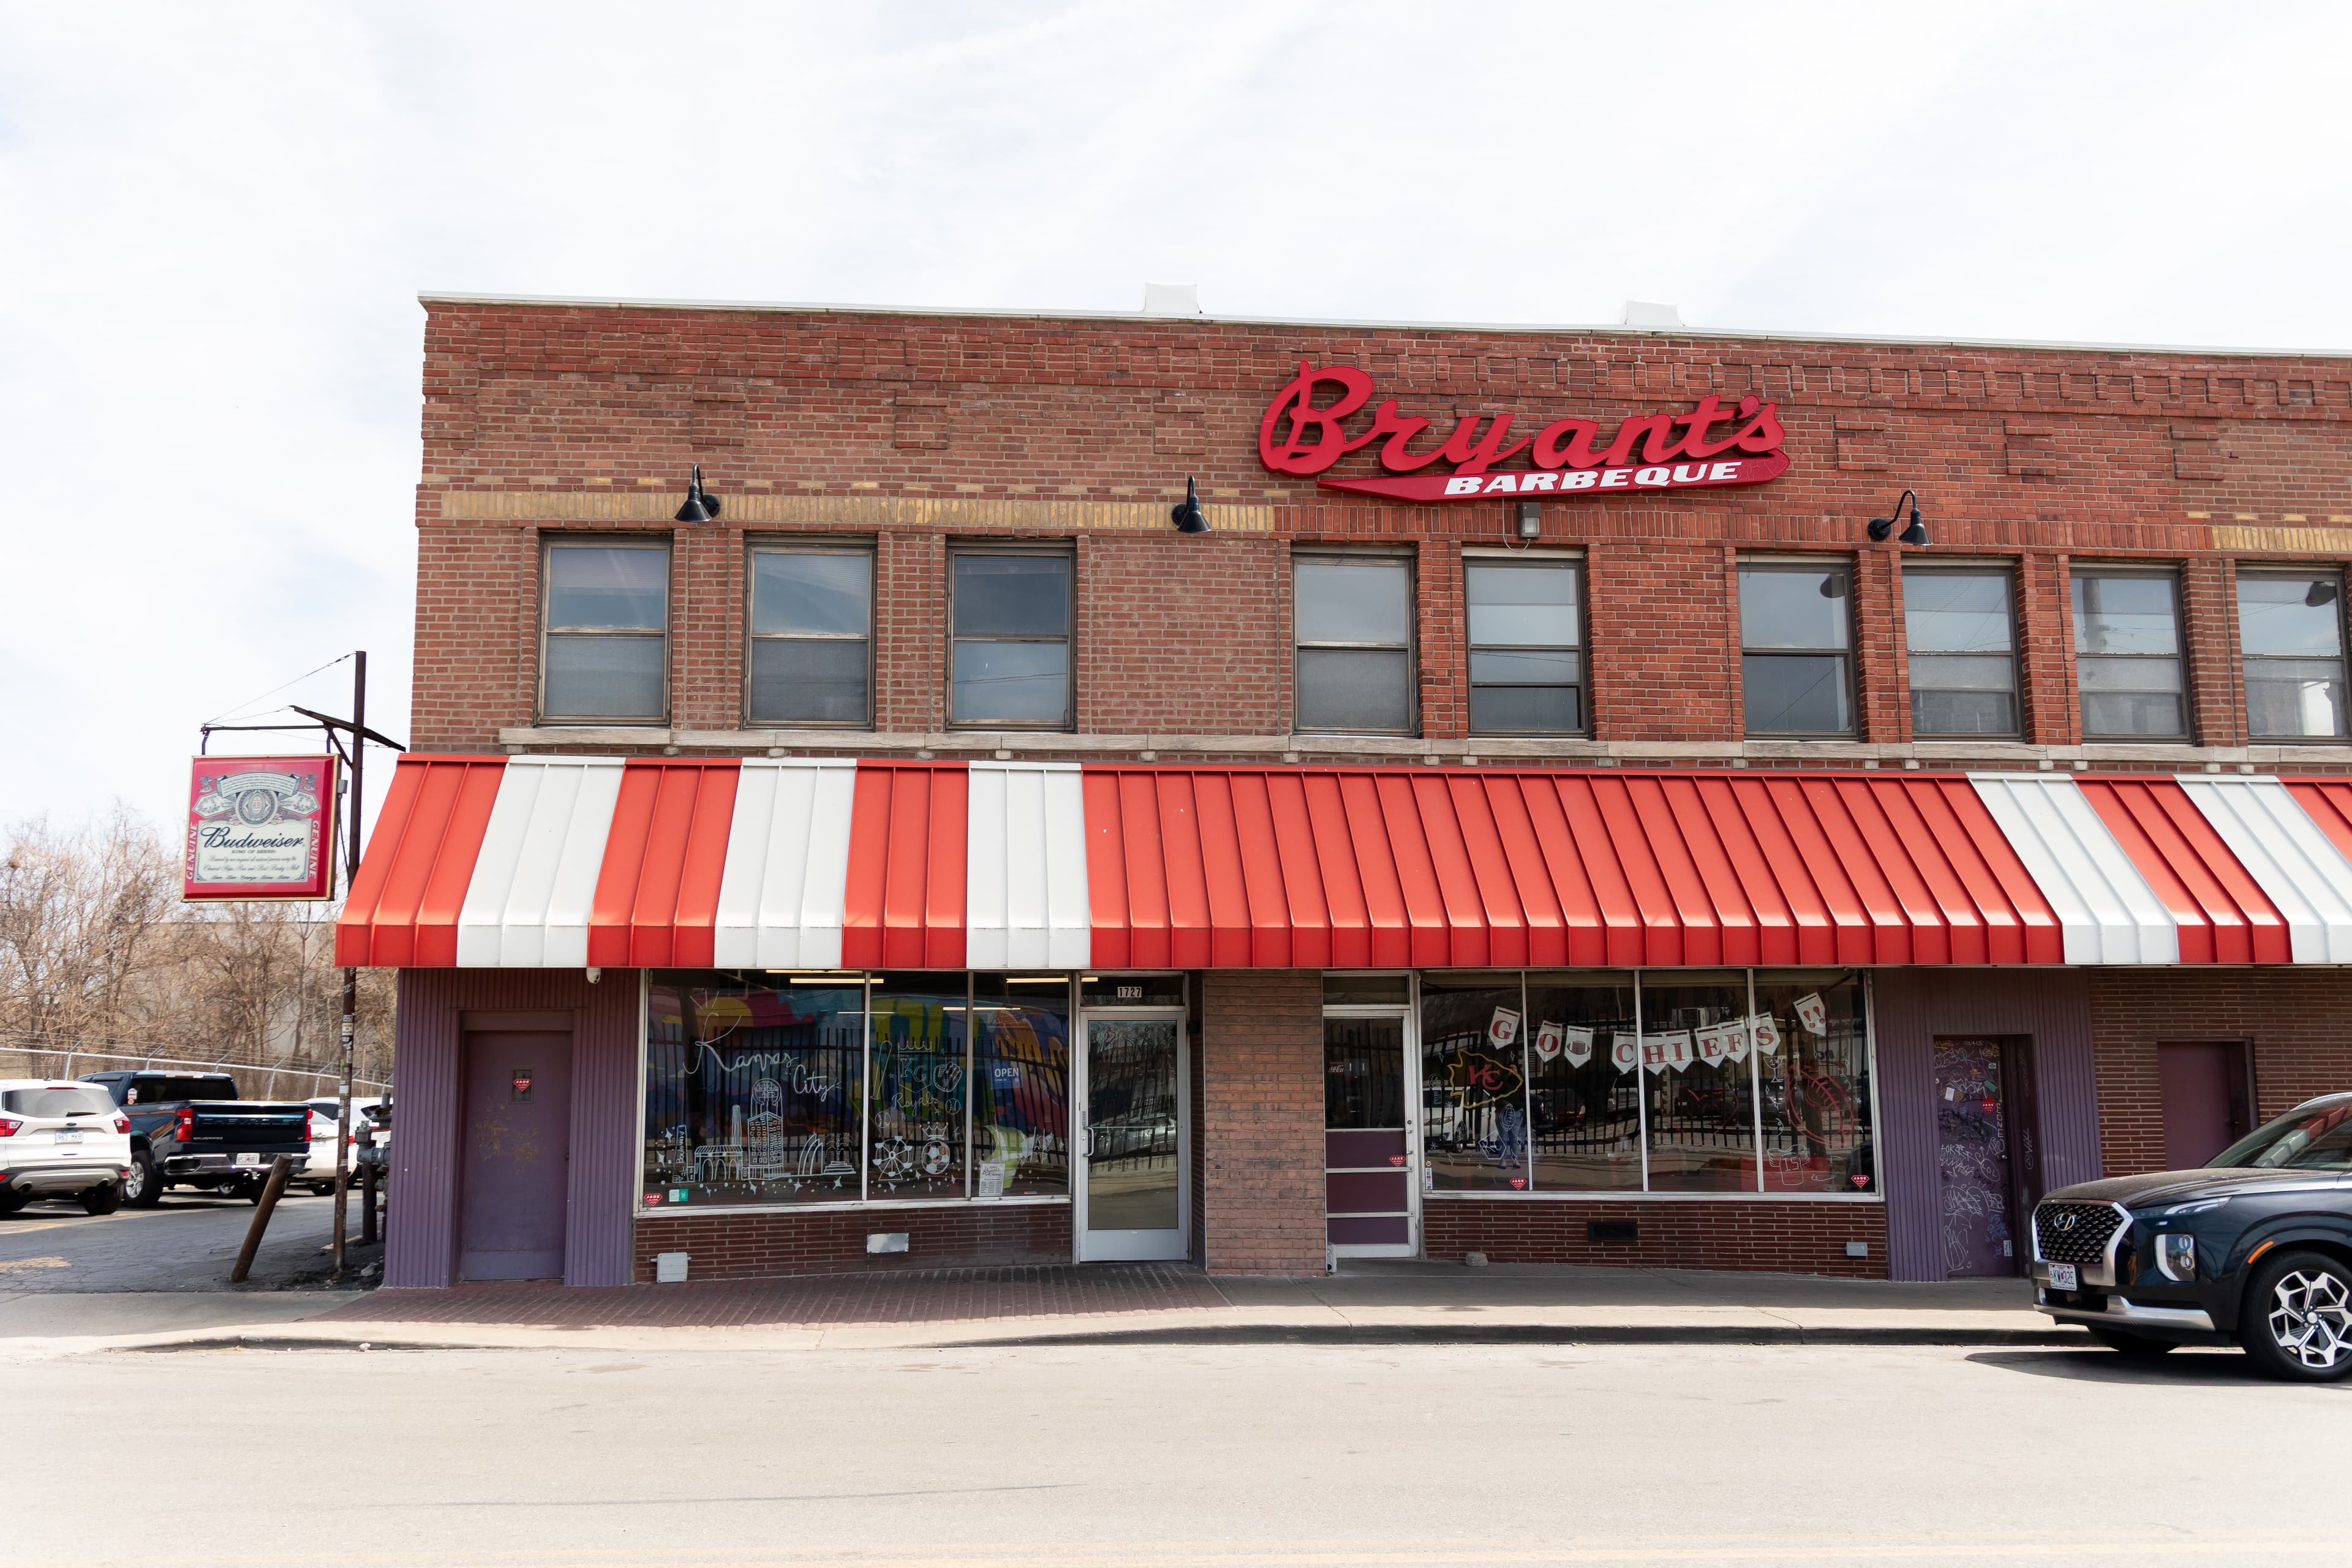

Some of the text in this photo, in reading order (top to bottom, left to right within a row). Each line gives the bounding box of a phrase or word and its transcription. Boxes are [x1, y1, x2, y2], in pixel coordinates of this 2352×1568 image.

[1259, 360, 1785, 477] Bryant's
[1444, 461, 1743, 496] BARBEQUE
[186, 822, 198, 881] GENUINE
[200, 826, 304, 848] Budweiser
[309, 820, 320, 879] GENUINE
[1119, 987, 1141, 997] 1727
[683, 1012, 800, 1075] Kansas
[1616, 1025, 1774, 1065] CHIEFS
[794, 1065, 837, 1102] City
[900, 1058, 927, 1082] KC
[994, 1068, 1019, 1077] OPEN
[1469, 1064, 1504, 1090] KC
[892, 1092, 938, 1117] Royals
[676, 1131, 685, 1163] Boulevard
[1982, 1164, 1997, 1177] LOL
